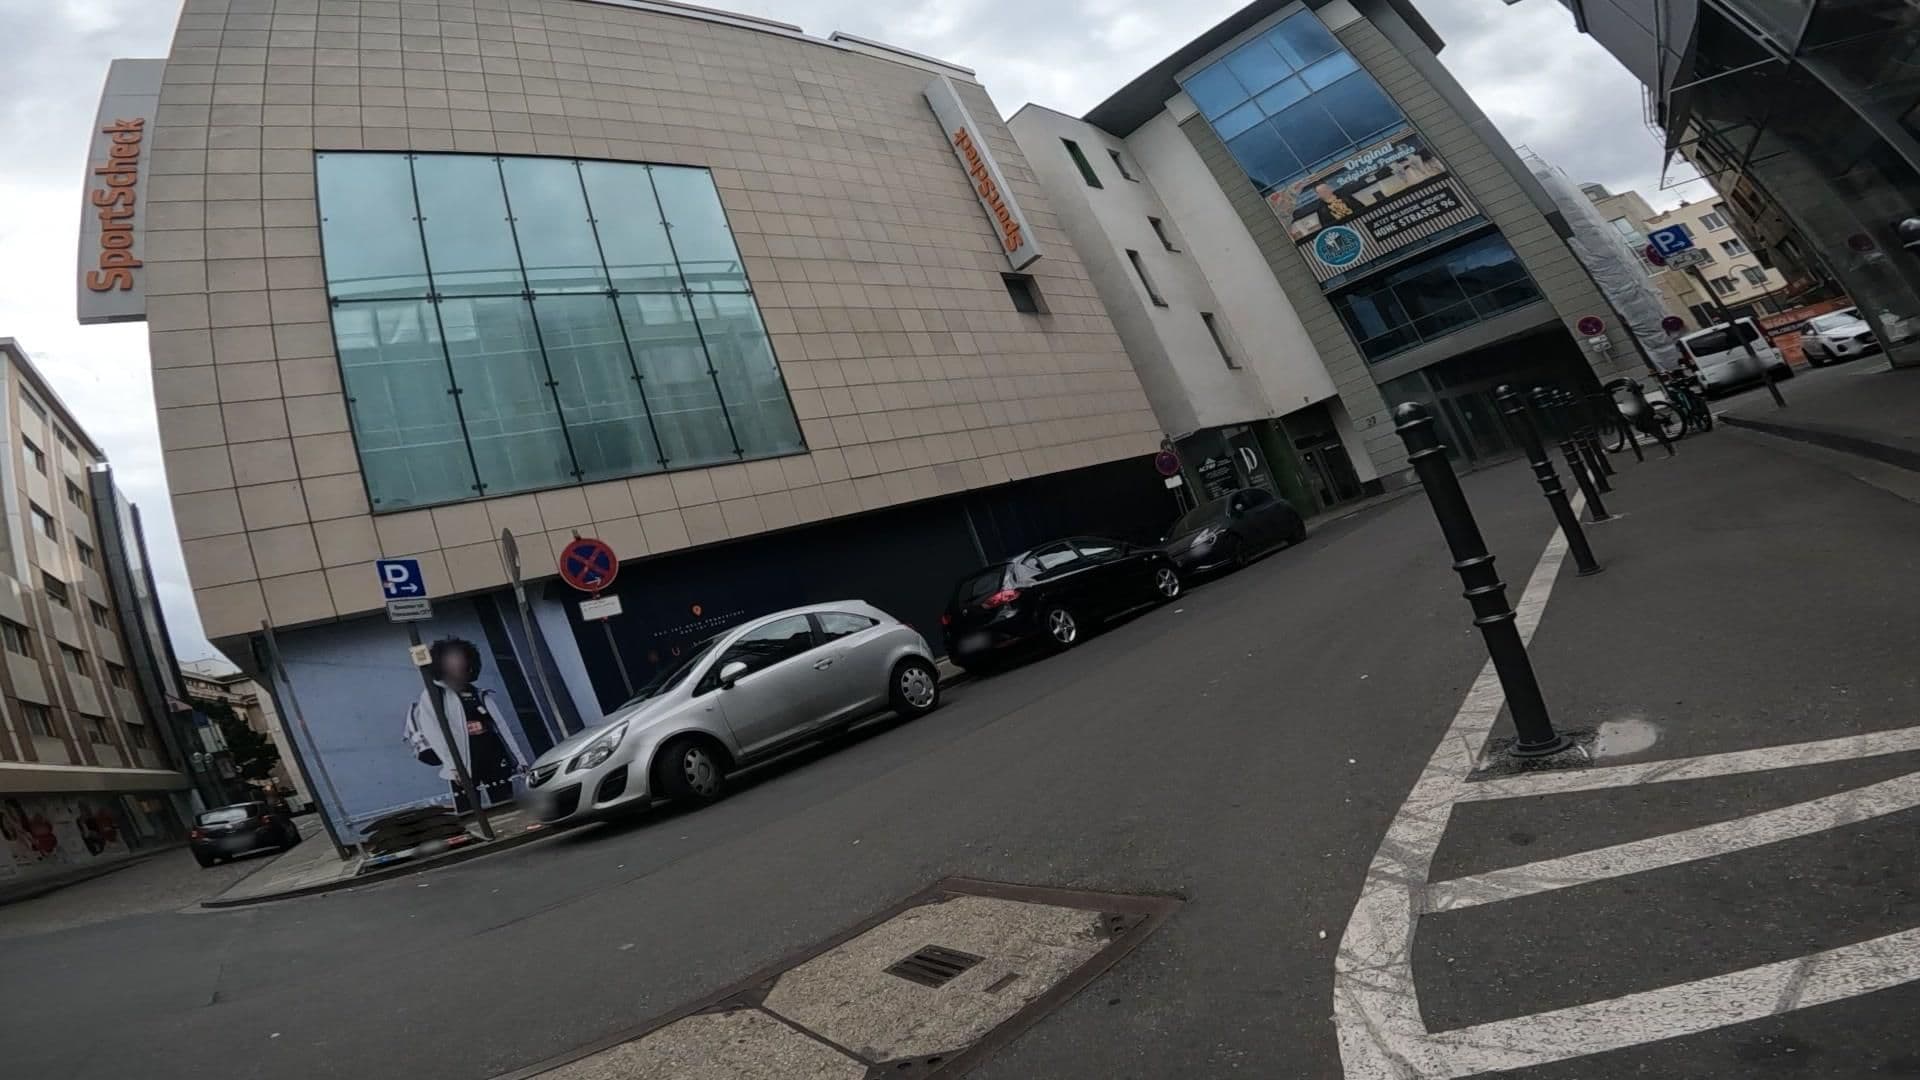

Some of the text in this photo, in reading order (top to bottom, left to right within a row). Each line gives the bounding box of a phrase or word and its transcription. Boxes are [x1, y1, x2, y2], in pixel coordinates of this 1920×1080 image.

[1336, 163, 1377, 186] Belgische
[1377, 146, 1416, 168] Pommes
[1344, 142, 1393, 170] Original
[86, 117, 145, 291] SportScheck
[953, 126, 1024, 253] SportScheck
[1398, 204, 1440, 227] STRASSE
[1440, 198, 1456, 209] 96
